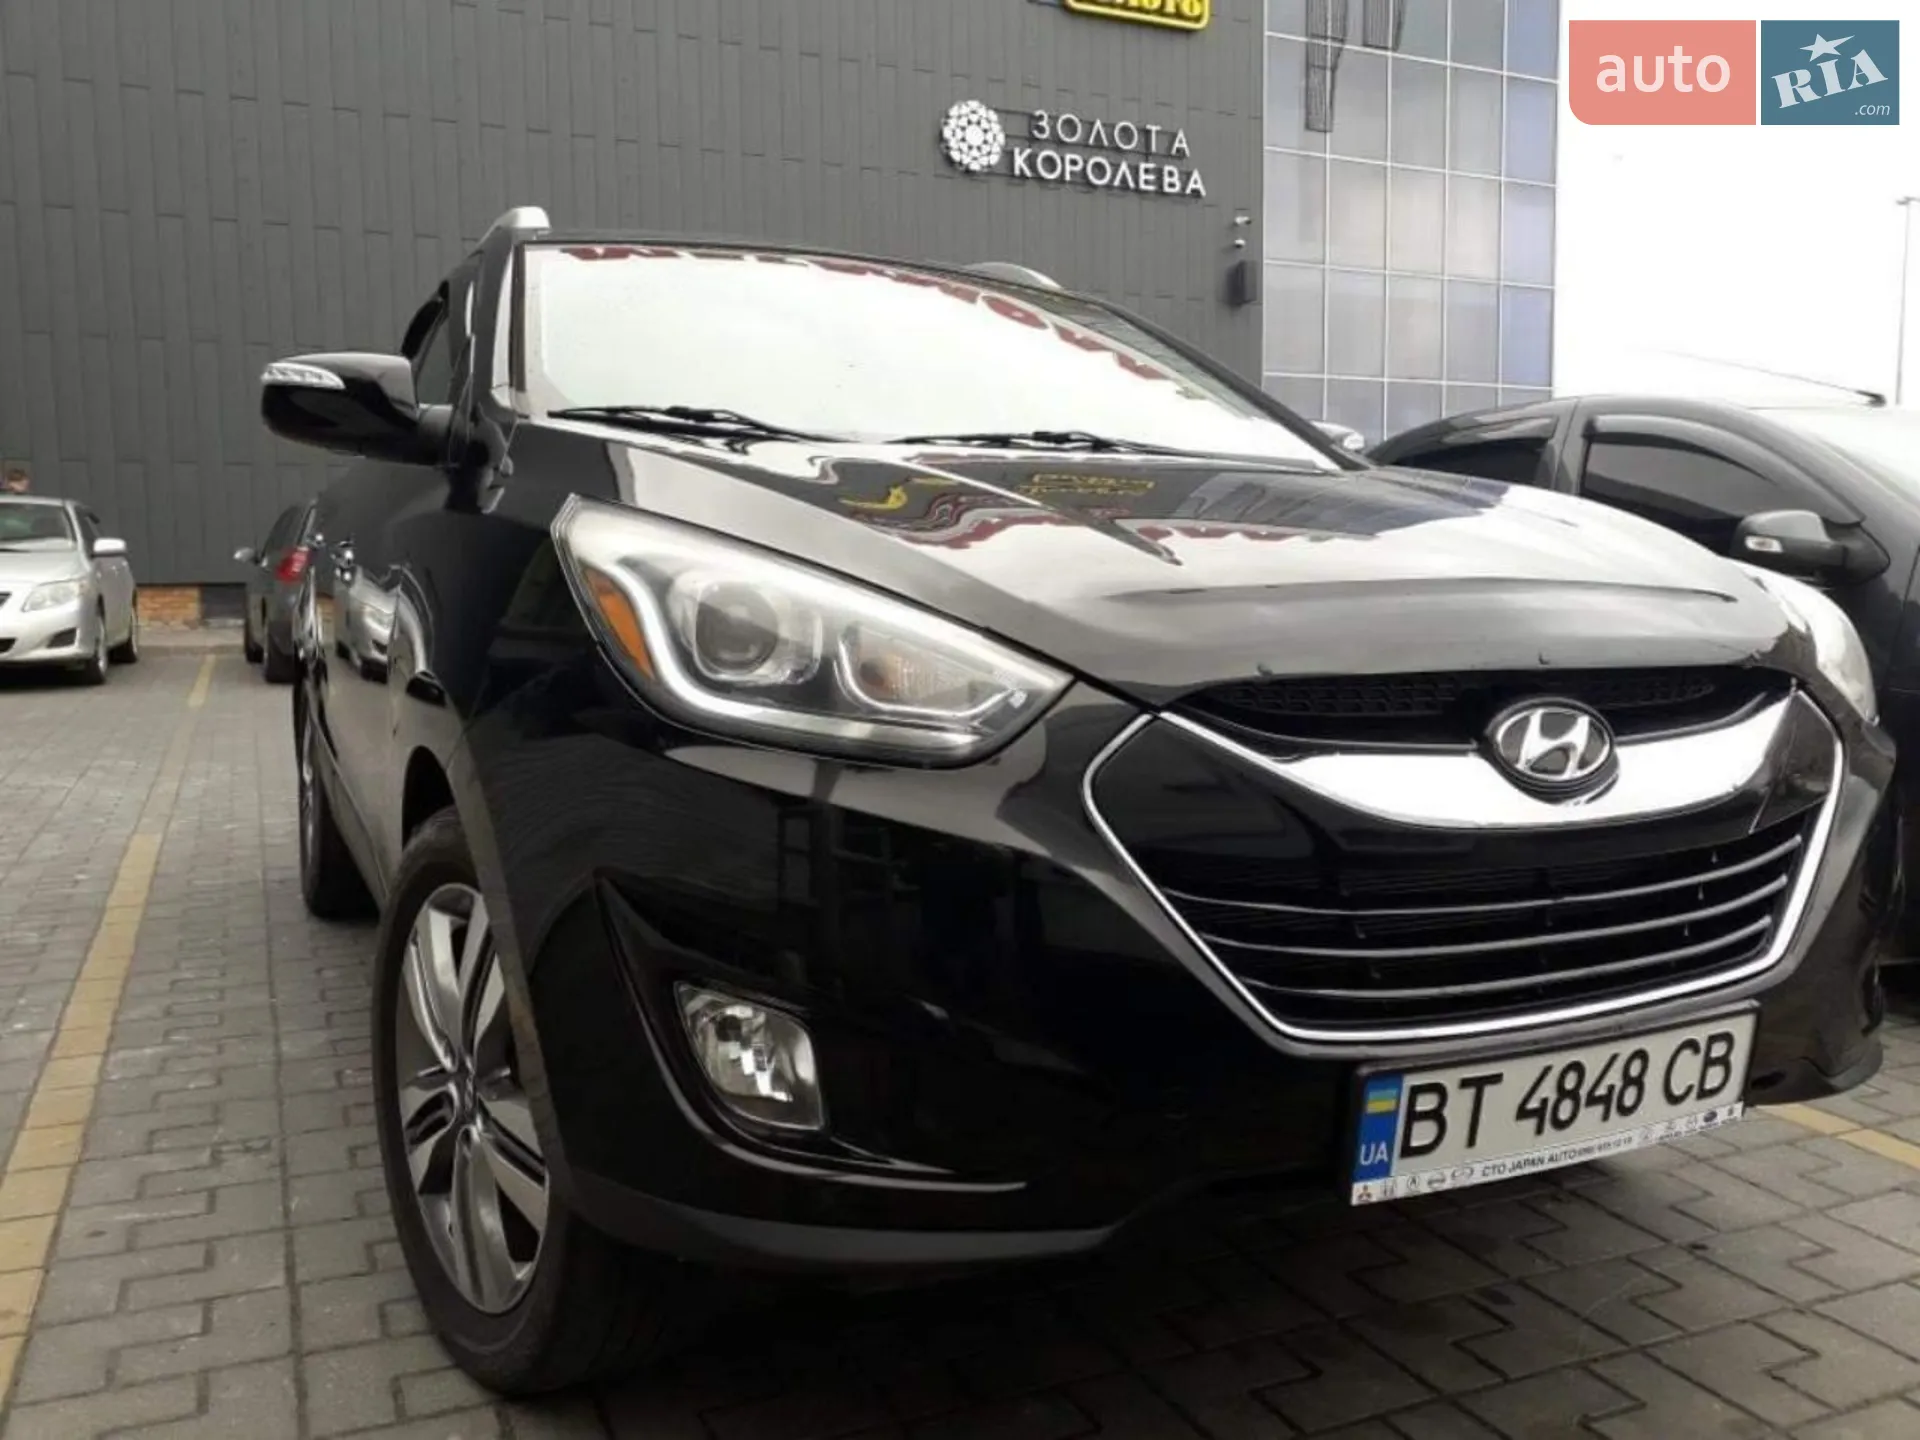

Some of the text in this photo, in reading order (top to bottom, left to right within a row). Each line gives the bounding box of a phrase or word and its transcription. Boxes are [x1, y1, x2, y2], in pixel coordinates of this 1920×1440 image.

[1032, 109, 1191, 158] ЗОЛОТА
[1012, 147, 1207, 197] КОРОЛЕВА
[1399, 1030, 1736, 1159] BT 4848 CB
[1360, 1141, 1388, 1165] UA
